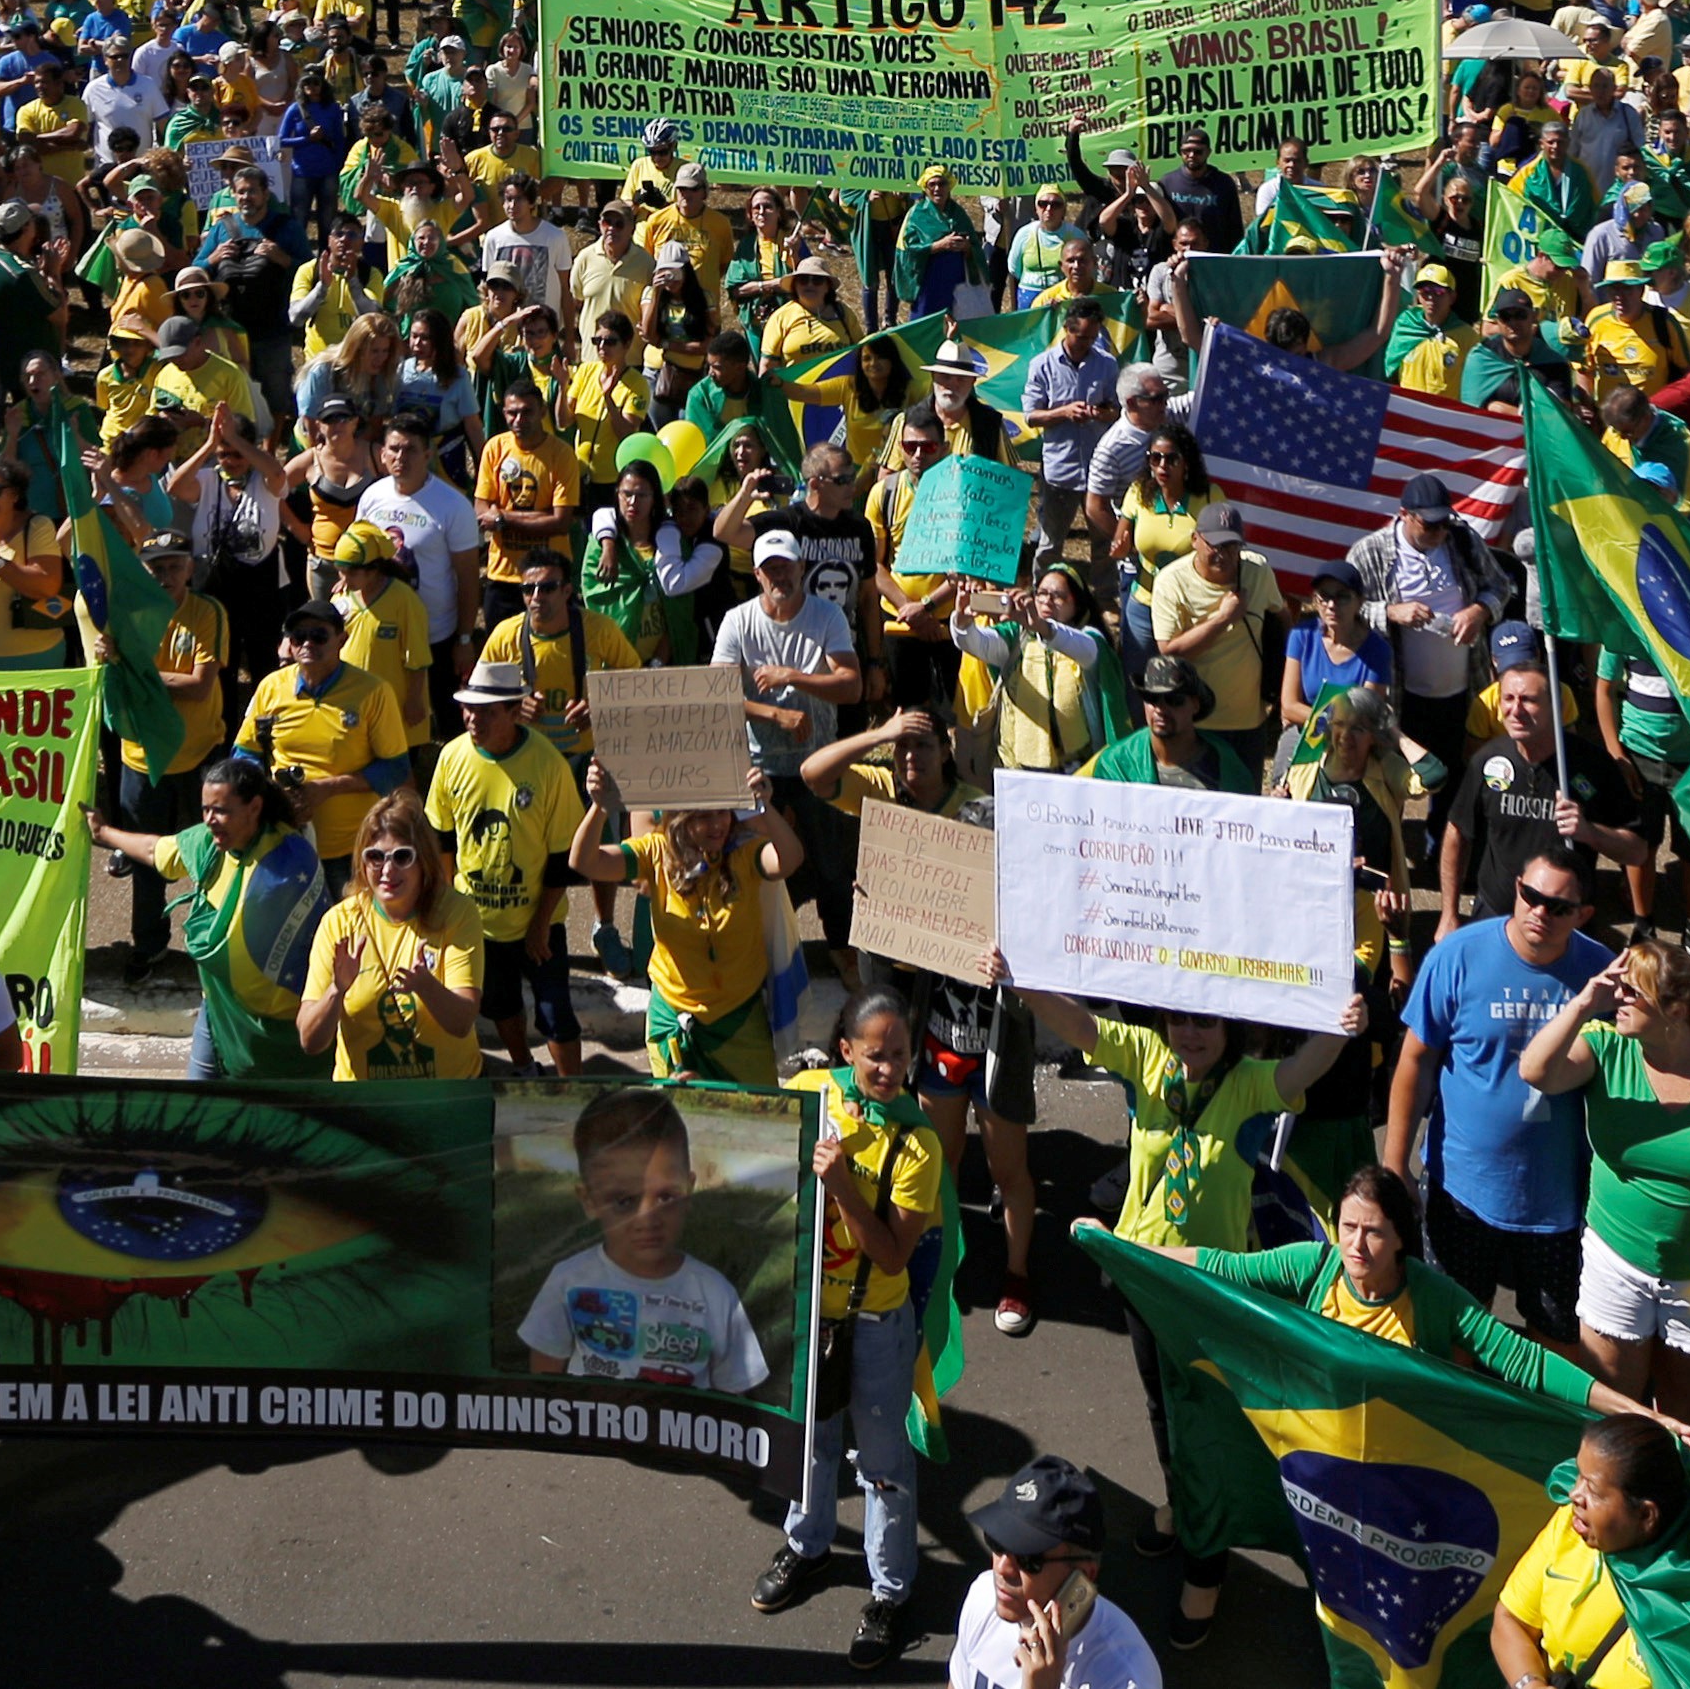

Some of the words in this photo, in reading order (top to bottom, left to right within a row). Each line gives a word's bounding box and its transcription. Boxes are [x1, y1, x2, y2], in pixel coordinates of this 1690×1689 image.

[1127, 13, 1139, 33] O
[1144, 6, 1196, 31] BRASIL
[568, 15, 685, 51] SENHORES
[693, 25, 864, 65] CONGRESSISTAS
[1167, 28, 1254, 69] VAMOS
[558, 49, 587, 77] NA
[594, 53, 675, 84] GRANDE
[683, 58, 770, 92] MAIORIA
[775, 61, 813, 93] SÃO
[825, 67, 875, 97] UMA
[882, 68, 992, 100] VERGONHA
[1004, 51, 1081, 76] QUEREMOS
[558, 81, 572, 110] A
[578, 81, 650, 113] NOSSA
[1061, 73, 1093, 93] COM
[1145, 73, 1243, 117] BRASIL
[1250, 60, 1327, 107] ACIMA
[1333, 56, 1362, 87] DE
[1366, 46, 1425, 92] TUDO
[1013, 94, 1107, 119] BOLSONARO
[558, 113, 583, 138] OS
[702, 122, 859, 154] DEMONSTRARAM
[862, 130, 885, 155] DE
[891, 133, 927, 159] QUE
[929, 136, 978, 162] LADO
[1216, 109, 1298, 154] ACIMA
[1301, 107, 1329, 147] DE
[1339, 93, 1429, 142] TODOS!
[561, 144, 620, 165] CONTRA
[627, 147, 638, 166] O
[698, 147, 761, 172] CONTRA
[764, 154, 778, 173] A
[849, 155, 907, 182] CONTRA
[910, 161, 923, 182] O
[1005, 167, 1024, 187] DO
[596, 673, 689, 704] MERKEL
[703, 671, 741, 699] YOU
[596, 705, 633, 732] ARE
[643, 702, 729, 729] STUPID
[598, 735, 633, 757] THE
[647, 764, 711, 791] OURS
[866, 806, 995, 855] IMPEACHMENT
[1045, 802, 1095, 827] Brasil
[1214, 819, 1255, 842] JATO
[1259, 832, 1292, 853] para
[904, 838, 928, 860] DE
[1078, 838, 1155, 869] CORRUPÇÃO
[861, 846, 899, 874] DIAS
[901, 859, 974, 894] TOFFOLI
[860, 871, 971, 912] ALCOLUMBRE
[854, 920, 897, 949] MAIA
[856, 898, 918, 925] GILMAR
[919, 908, 989, 944] MENDES
[1158, 949, 1168, 966] O
[1178, 948, 1230, 974] GOVERNO
[1236, 955, 1306, 984] TRABALHAR
[62, 1383, 89, 1421] A
[98, 1383, 150, 1422] LEI
[160, 1384, 249, 1424] ANTI
[259, 1385, 385, 1428] CRIME
[392, 1390, 447, 1430] DO
[456, 1394, 649, 1444] MINISTRO
[658, 1408, 771, 1470] MORO
[1351, 1522, 1362, 1538] E
[1369, 1531, 1486, 1569] PROGRESSO
